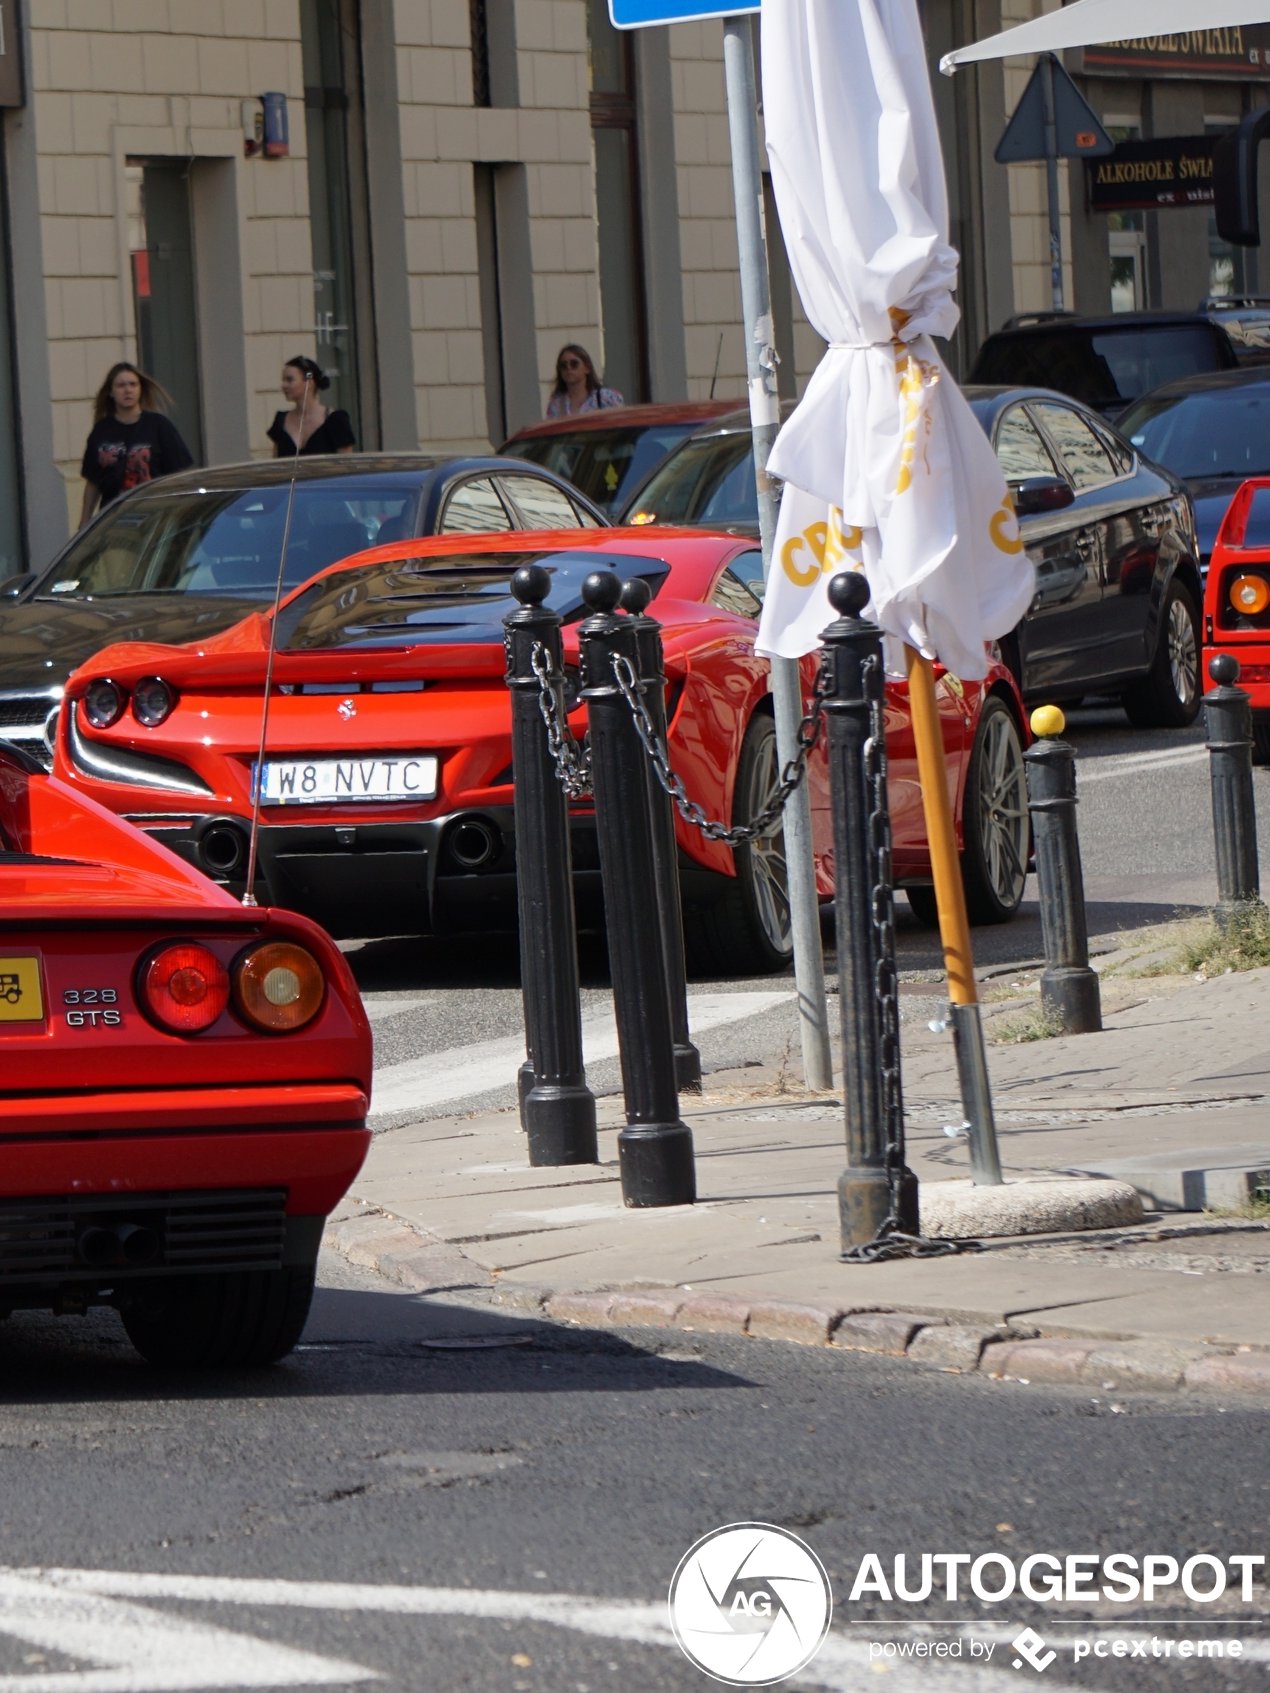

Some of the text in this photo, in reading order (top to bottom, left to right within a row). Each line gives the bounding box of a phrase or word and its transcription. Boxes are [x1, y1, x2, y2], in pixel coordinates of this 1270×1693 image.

[1096, 160, 1174, 184] ALKOHOLE
[279, 761, 421, 794] W8 NVTC
[64, 989, 117, 1004] 328
[66, 1010, 121, 1027] GTS
